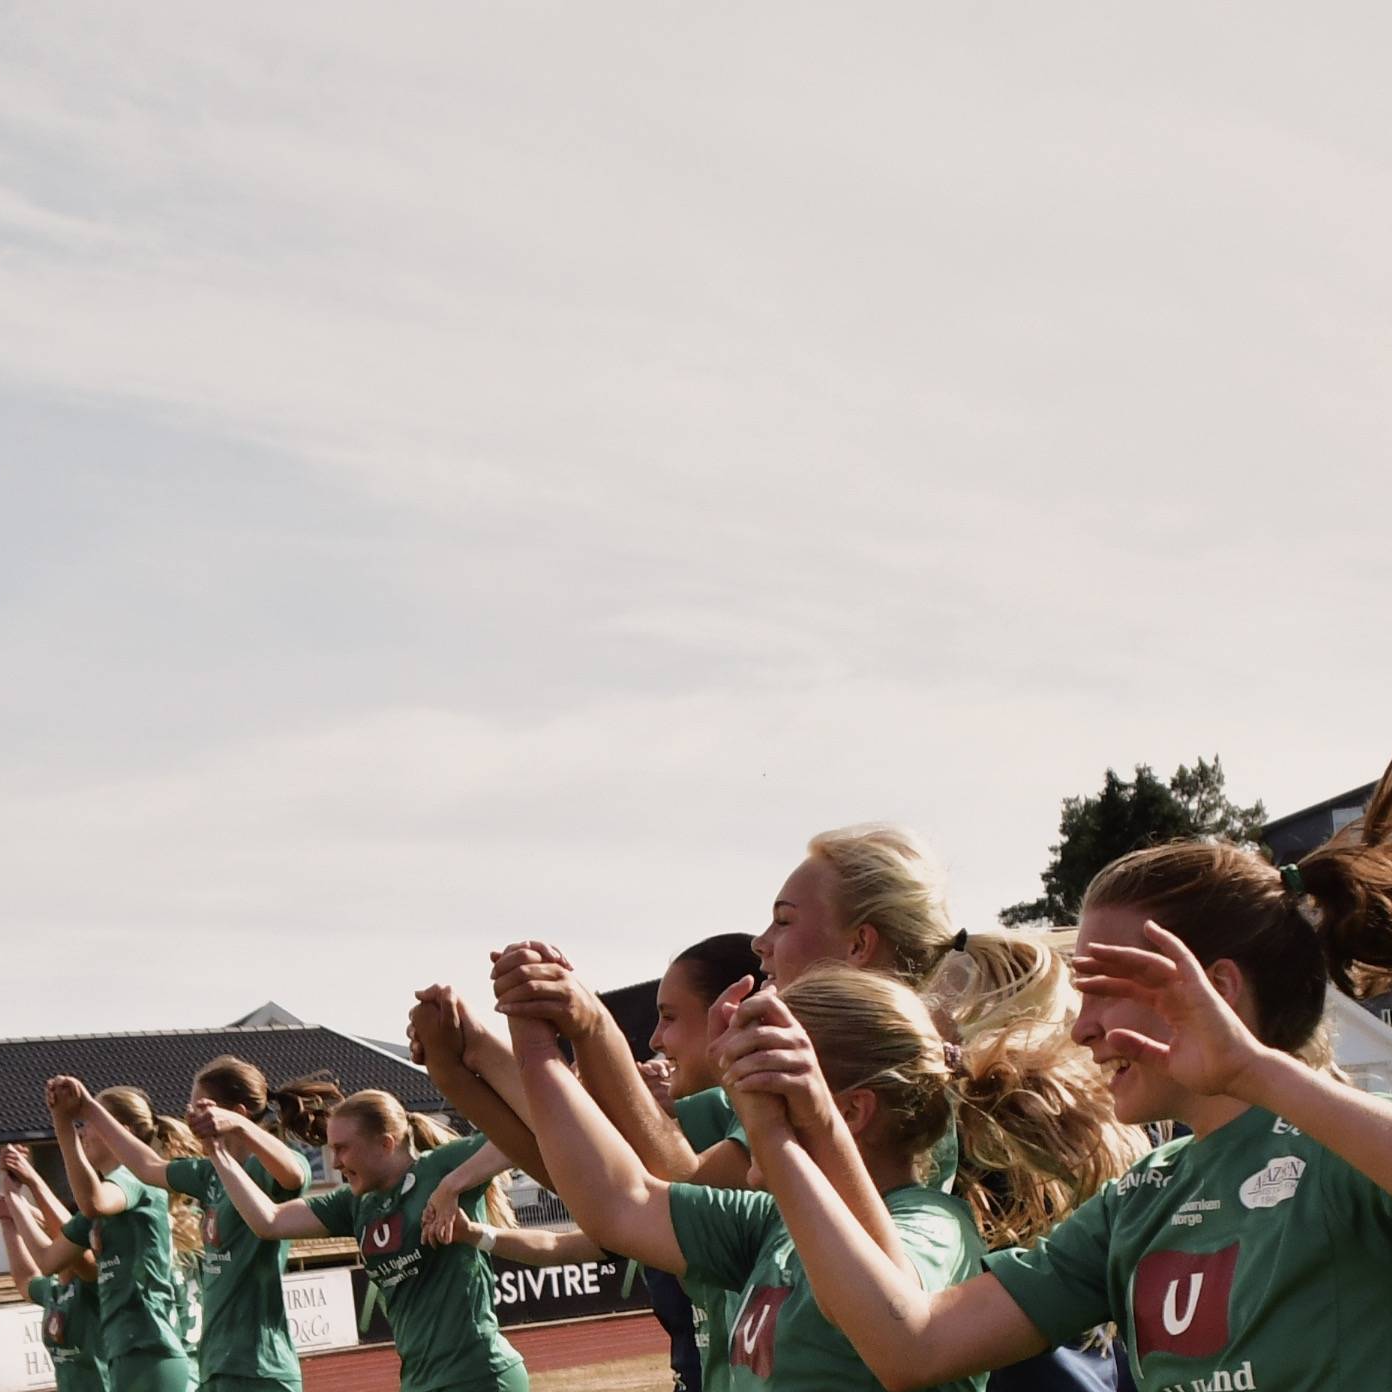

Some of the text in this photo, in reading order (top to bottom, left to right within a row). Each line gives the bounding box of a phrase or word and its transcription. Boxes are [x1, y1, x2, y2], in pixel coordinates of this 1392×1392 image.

[373, 1223, 390, 1248] U
[600, 1263, 616, 1275] AS
[1163, 1272, 1205, 1336] U
[744, 1304, 771, 1355] U
